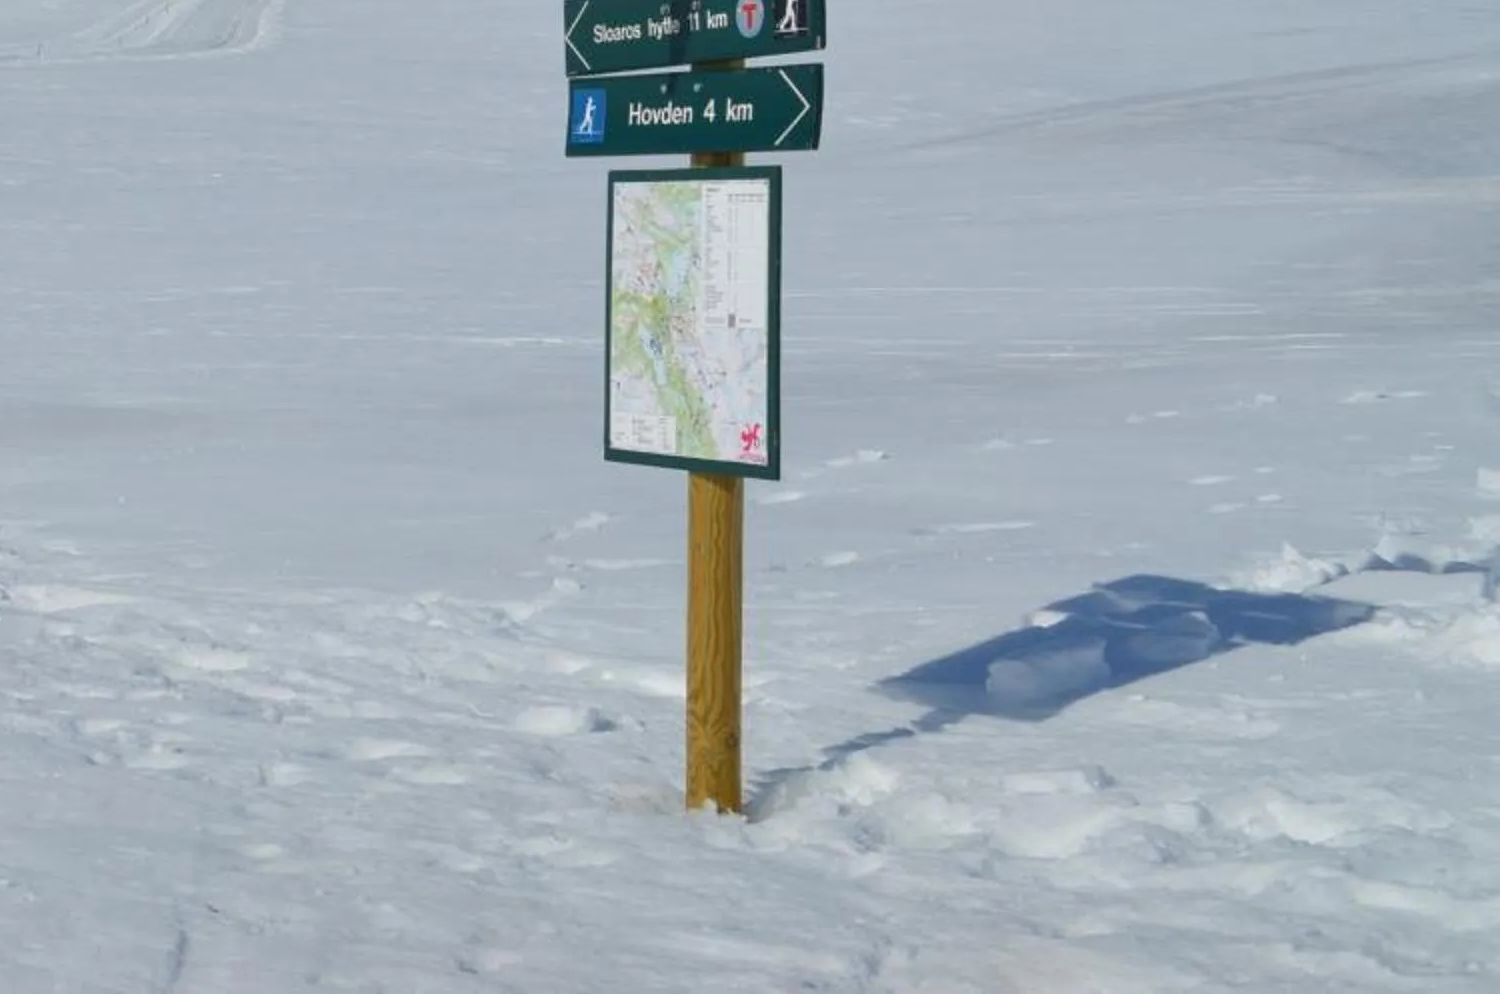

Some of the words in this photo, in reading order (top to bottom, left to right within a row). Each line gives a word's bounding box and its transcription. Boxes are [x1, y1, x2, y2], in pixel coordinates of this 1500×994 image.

[687, 11, 700, 31] 11
[706, 9, 729, 29] km
[629, 102, 692, 126] Hovden
[703, 99, 715, 122] 4
[726, 98, 753, 121] km
